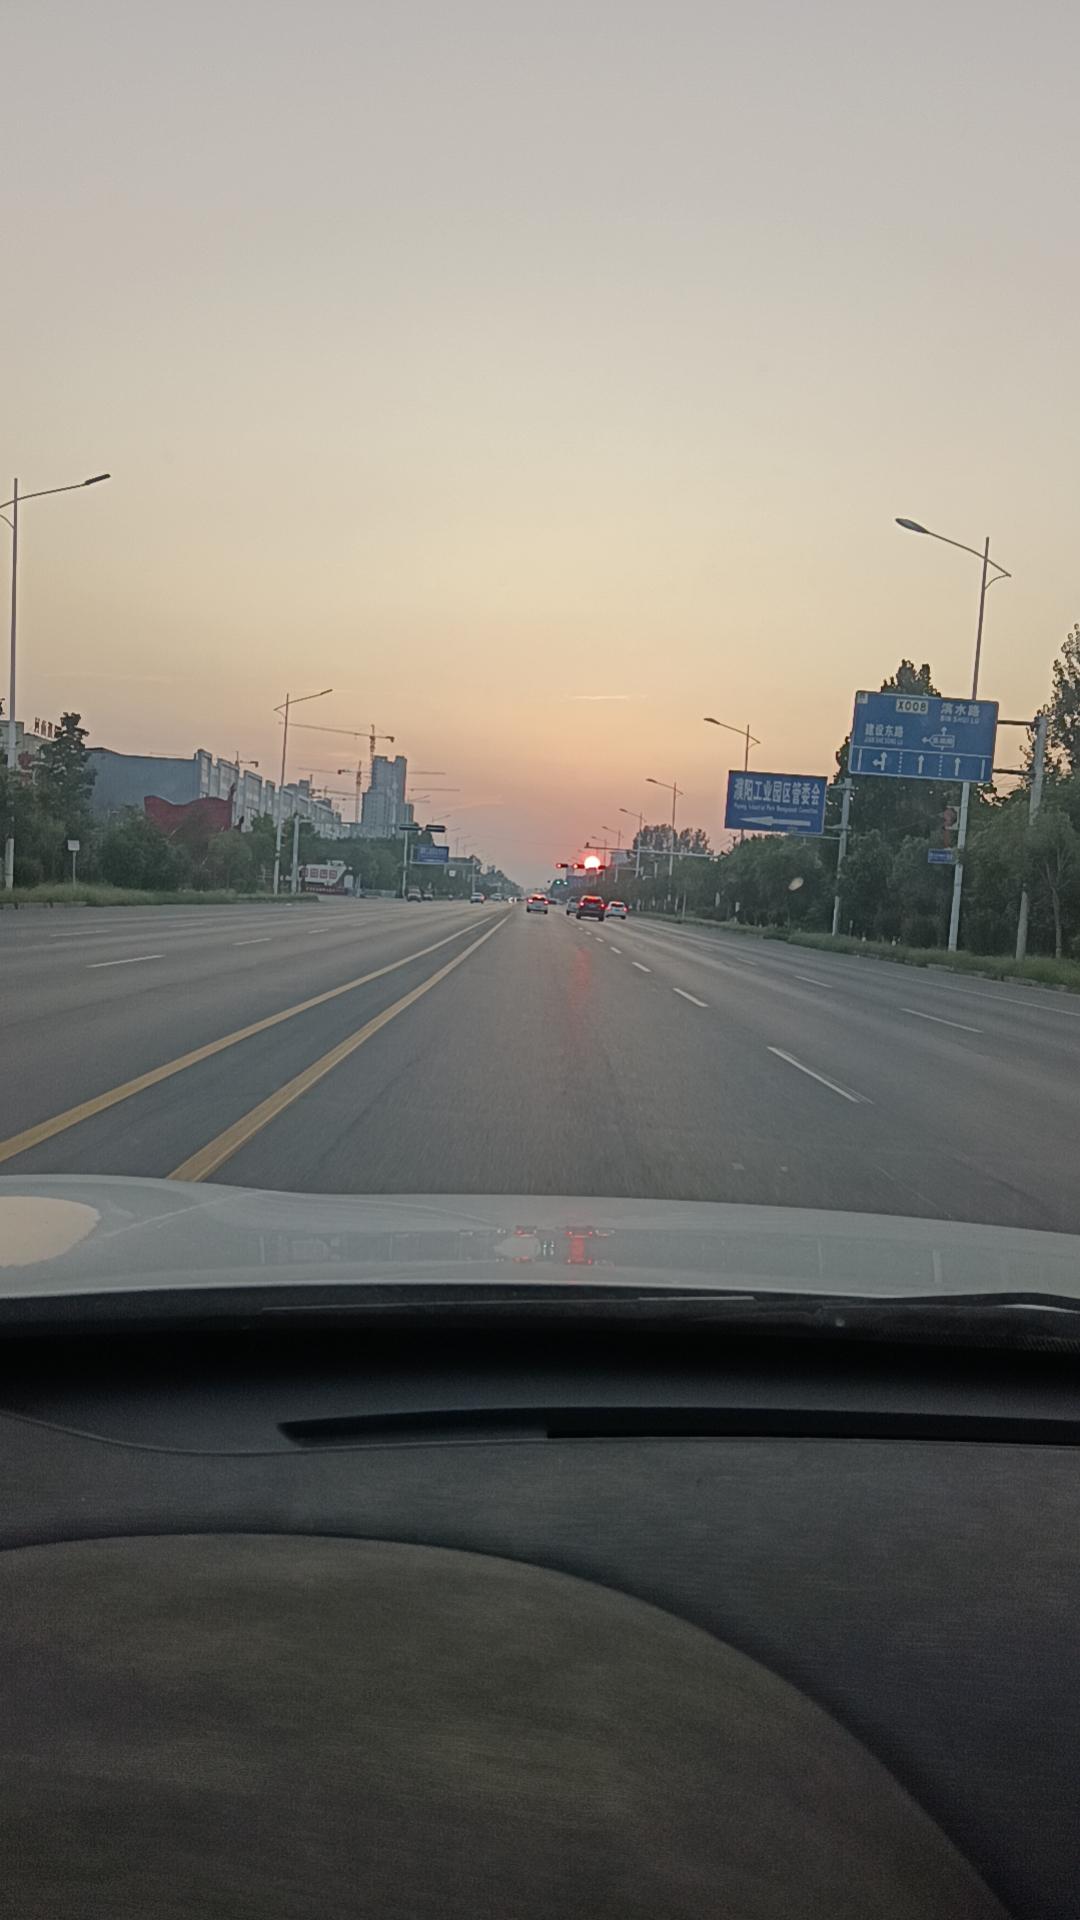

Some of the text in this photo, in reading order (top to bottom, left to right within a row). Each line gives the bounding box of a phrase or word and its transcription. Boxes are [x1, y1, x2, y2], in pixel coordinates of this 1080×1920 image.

[898, 701, 928, 712] X008
[865, 723, 904, 737] 建设东路
[734, 777, 821, 806] 濮阳工业园区管委会
